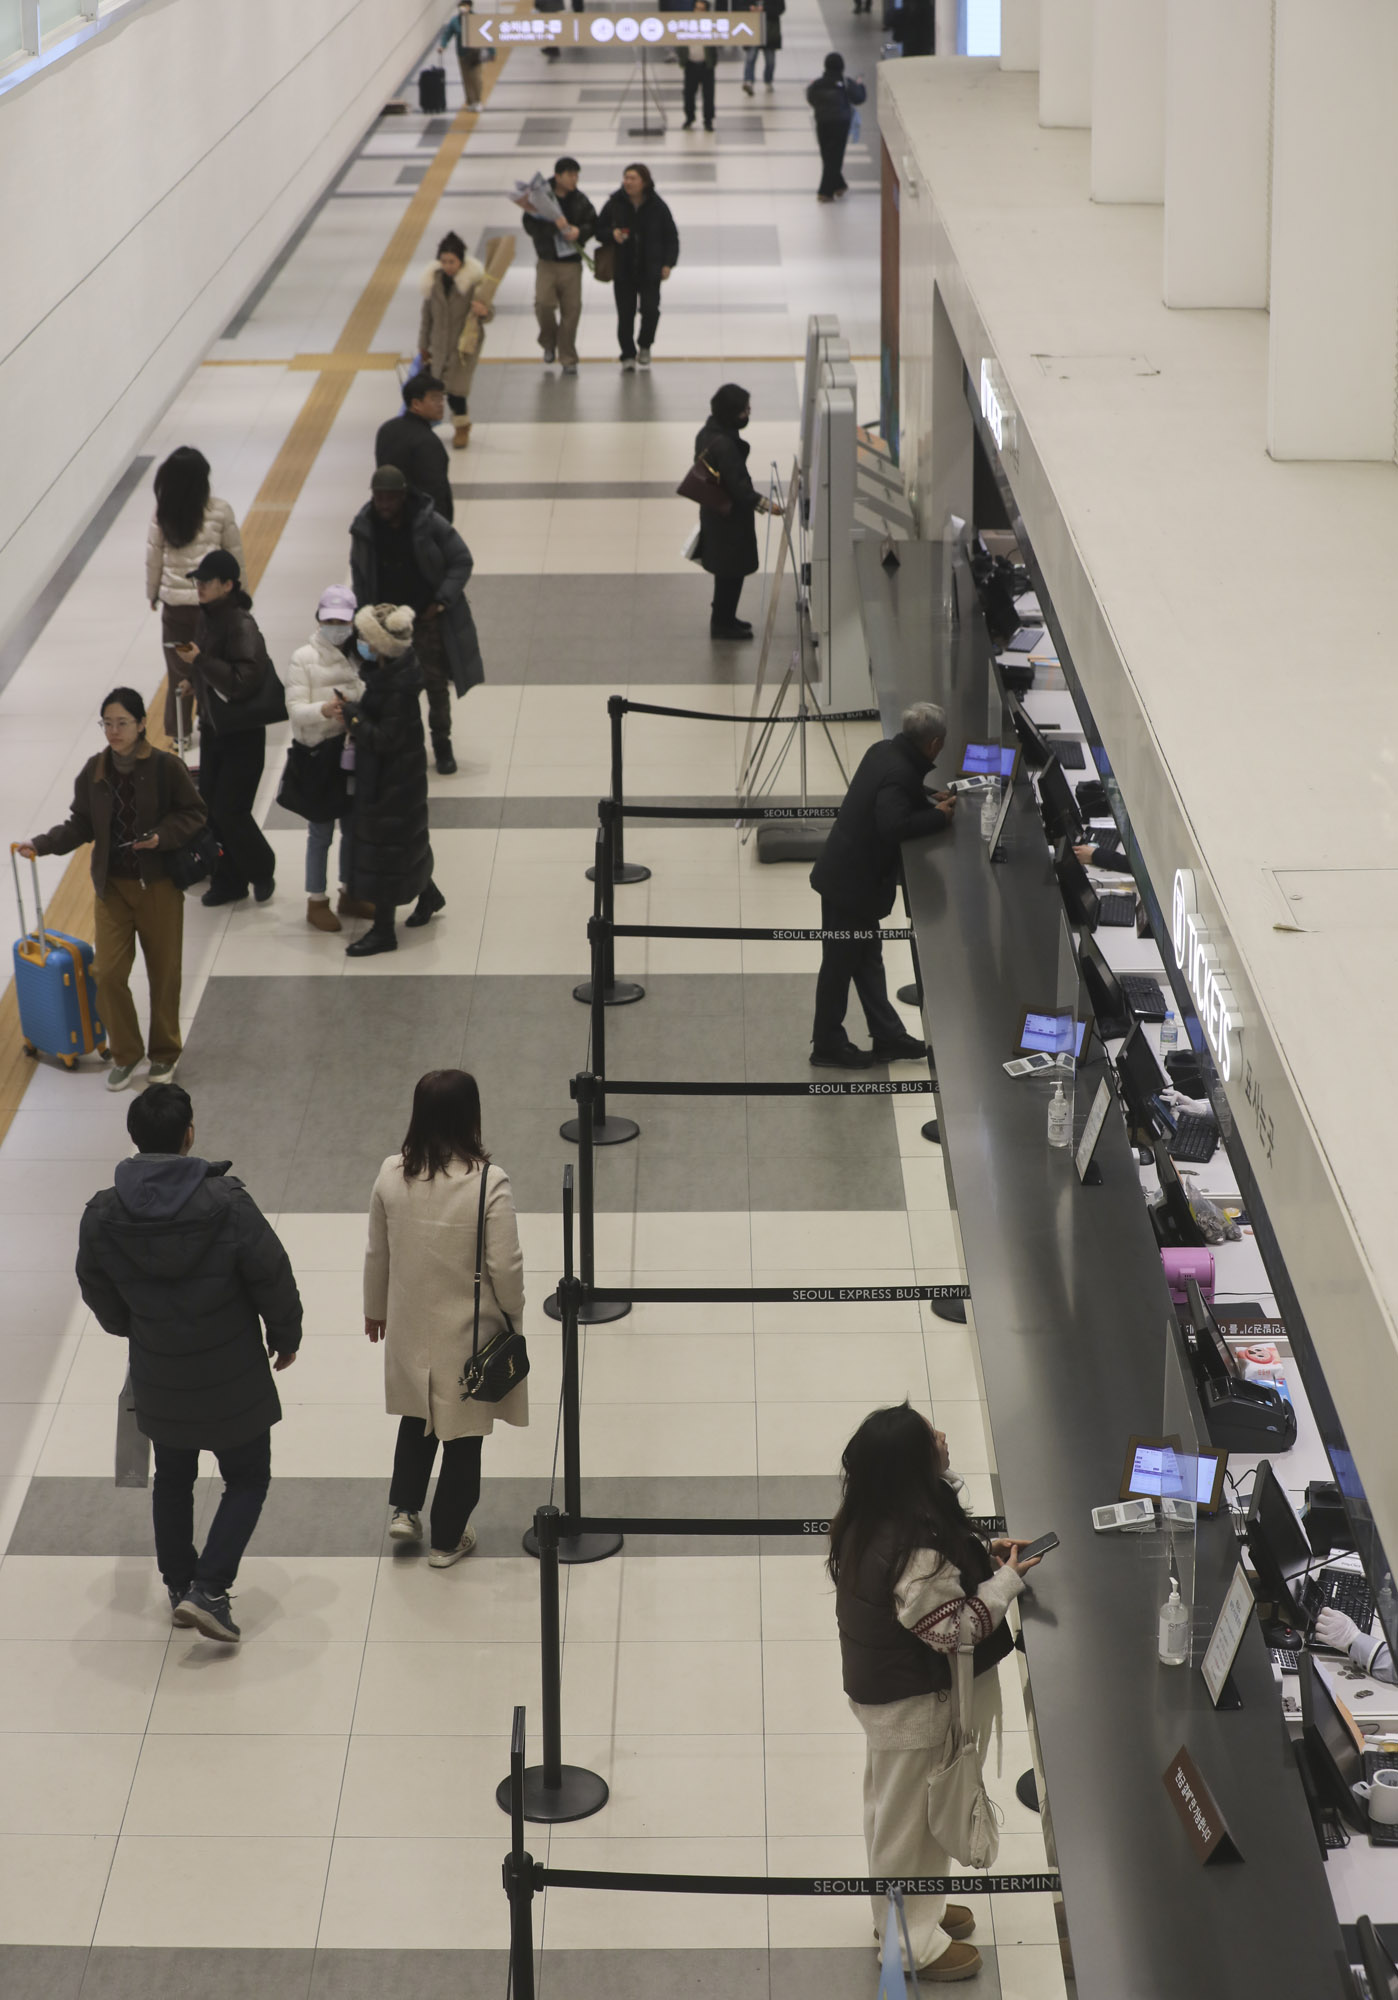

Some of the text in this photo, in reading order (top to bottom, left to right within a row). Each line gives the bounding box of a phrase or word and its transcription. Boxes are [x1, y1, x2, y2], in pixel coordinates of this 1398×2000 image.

[764, 808, 835, 817] SEOUL EXPRESS
[772, 930, 806, 940] SEOUL
[809, 930, 850, 940] EXPRESS
[853, 930, 873, 939] BUS
[1187, 913, 1232, 1082] TICKETS
[808, 1084, 847, 1094] SEOUL
[850, 1083, 898, 1093] EXPRESS
[901, 1082, 923, 1092] BUS
[792, 1290, 835, 1300] SEOUL
[839, 1288, 892, 1300] EXPRESS
[896, 1287, 920, 1298] BUS
[803, 1521, 831, 1533] SEO
[1193, 1806, 1212, 1842] 가능합니다
[813, 1880, 870, 1894] SEOUL
[875, 1879, 945, 1893] EXPRESS
[951, 1878, 983, 1892] BUS
